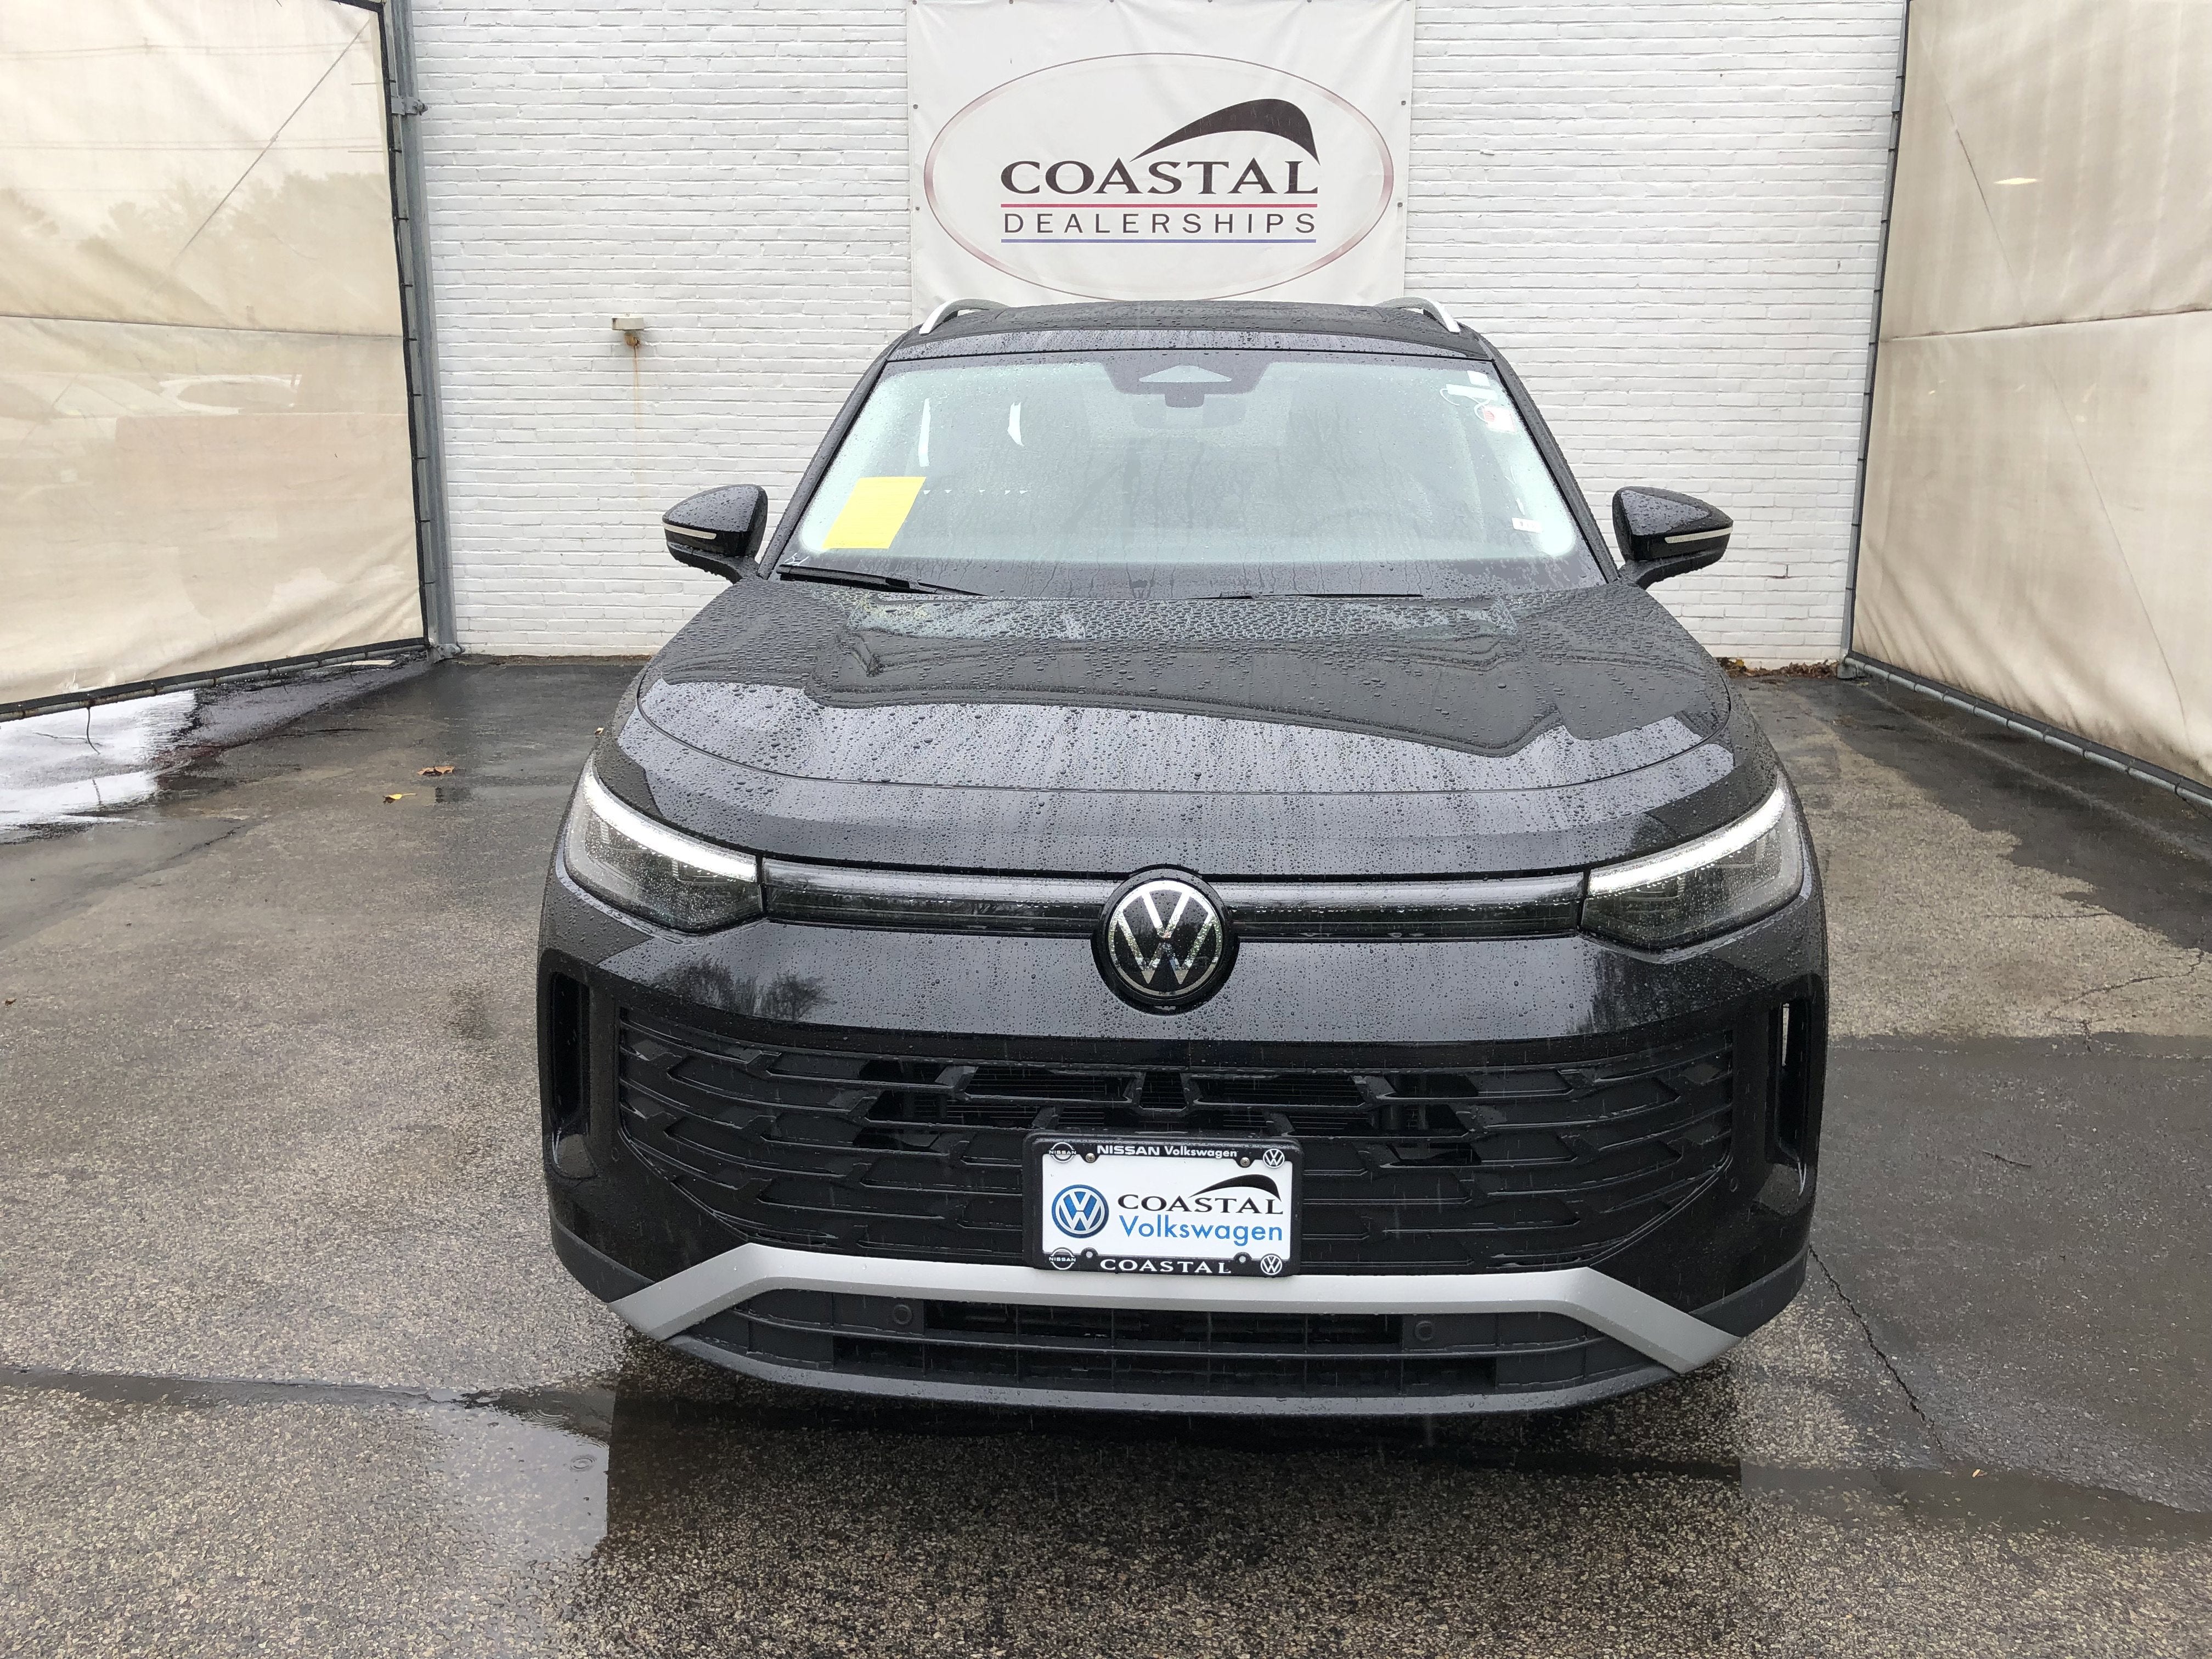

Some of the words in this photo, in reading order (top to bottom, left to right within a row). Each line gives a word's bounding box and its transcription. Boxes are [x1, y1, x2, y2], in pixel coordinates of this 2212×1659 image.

[1001, 157, 1318, 195] COASTAL
[1004, 213, 1315, 234] DEALERSHIPS
[1097, 1145, 1160, 1156] NISSAN
[1164, 1146, 1237, 1158] Volkswagen
[1118, 1194, 1284, 1215] COASTAL
[1119, 1214, 1282, 1246] Volkswagen
[1100, 1259, 1232, 1274] COASTAL
